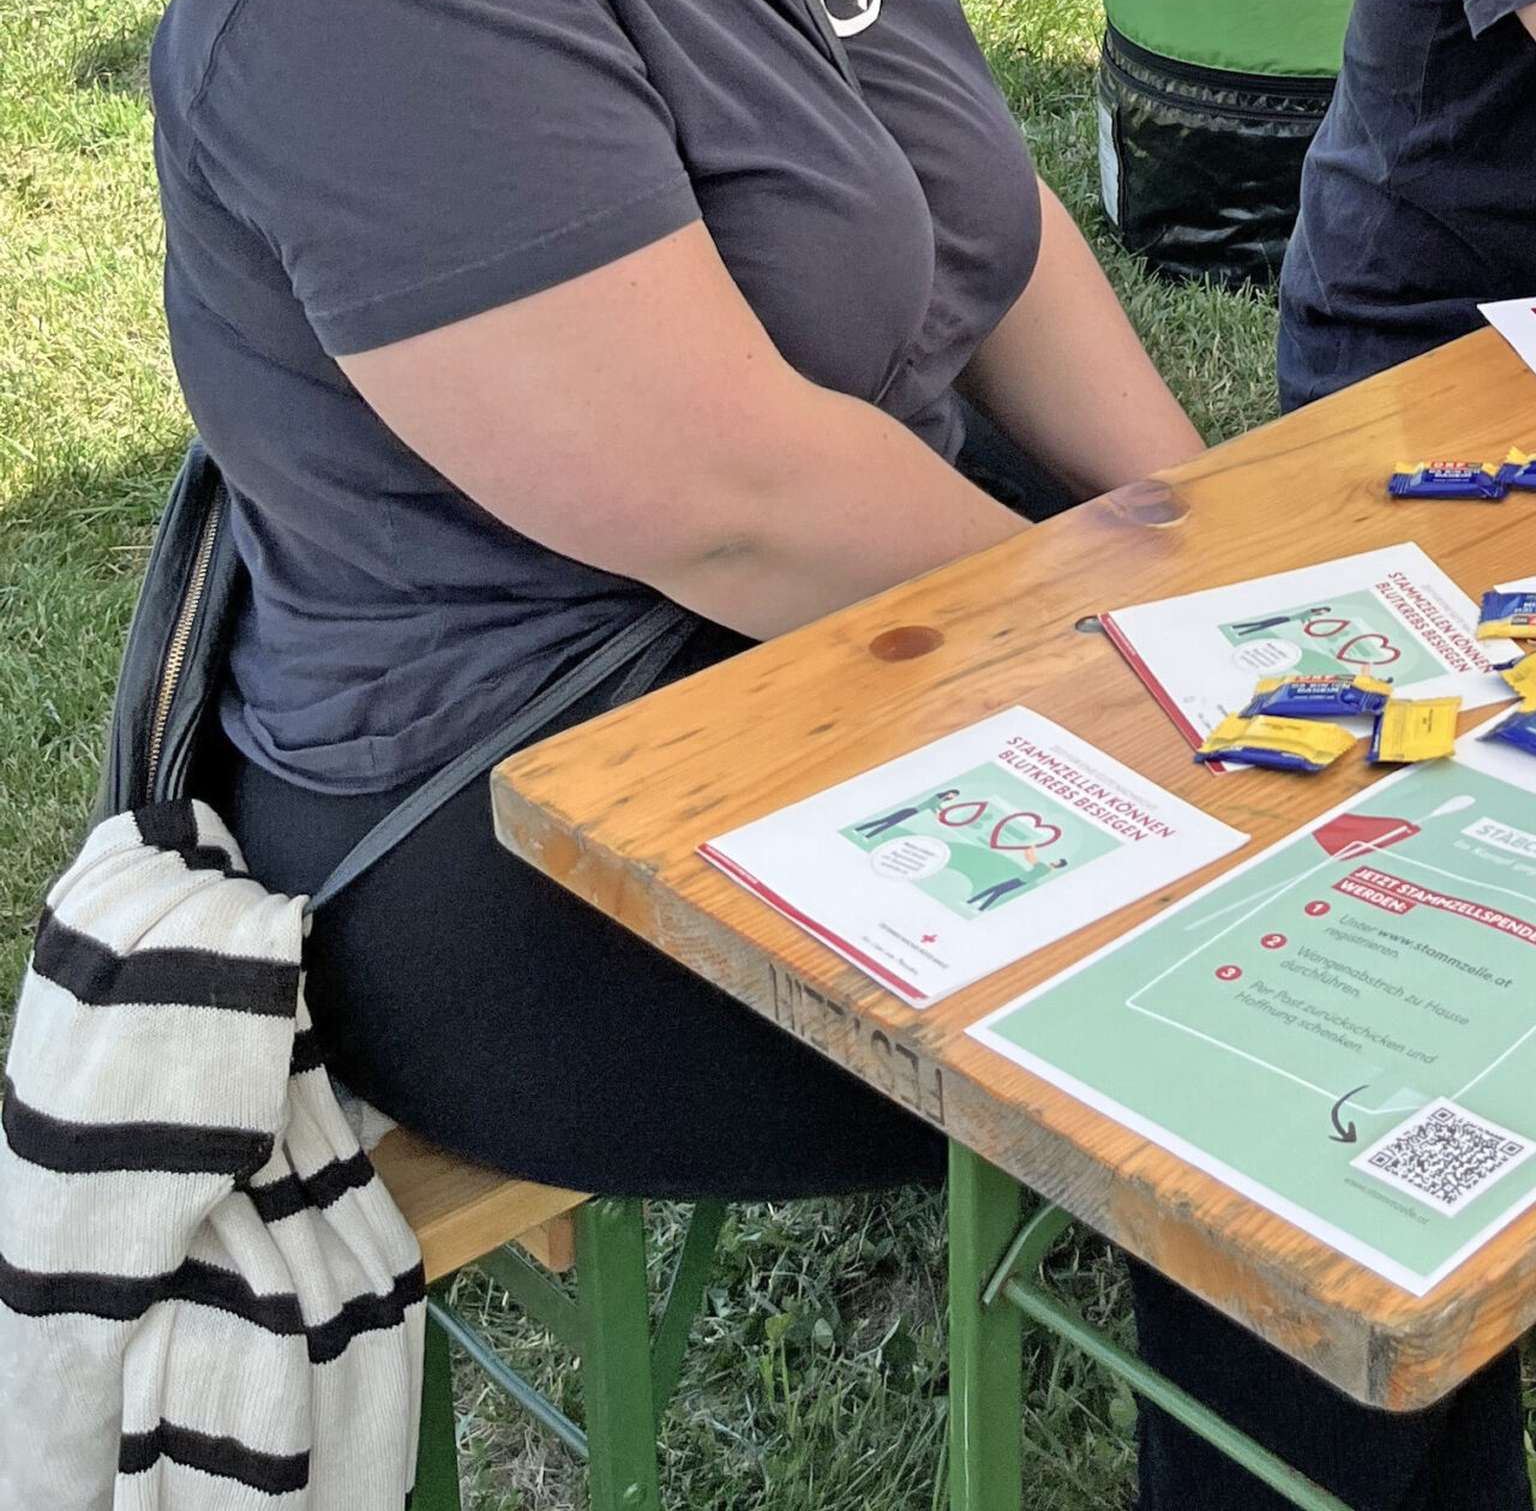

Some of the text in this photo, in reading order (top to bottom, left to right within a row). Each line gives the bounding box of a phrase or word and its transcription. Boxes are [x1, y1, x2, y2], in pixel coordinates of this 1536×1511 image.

[1375, 581, 1470, 674] BLUTKREBS BESIEGEN
[1387, 570, 1456, 636] STAMMZELLEN
[998, 749, 1081, 801] BLUTKREBS
[1073, 795, 1149, 843] BESIEGEN
[1007, 736, 1110, 801] STAMMZELLEN
[1107, 793, 1177, 839] KÖNNEN
[1340, 879, 1409, 914] WERDEN:
[1354, 867, 1401, 890] JETZT
[1297, 945, 1471, 1027] Wangenabstrich zu Hause
[1339, 913, 1514, 989] Unter www.stammzelle.at
[1234, 991, 1298, 1026] Hoffnung
[1250, 979, 1439, 1065] Per Post zurückschicken und
